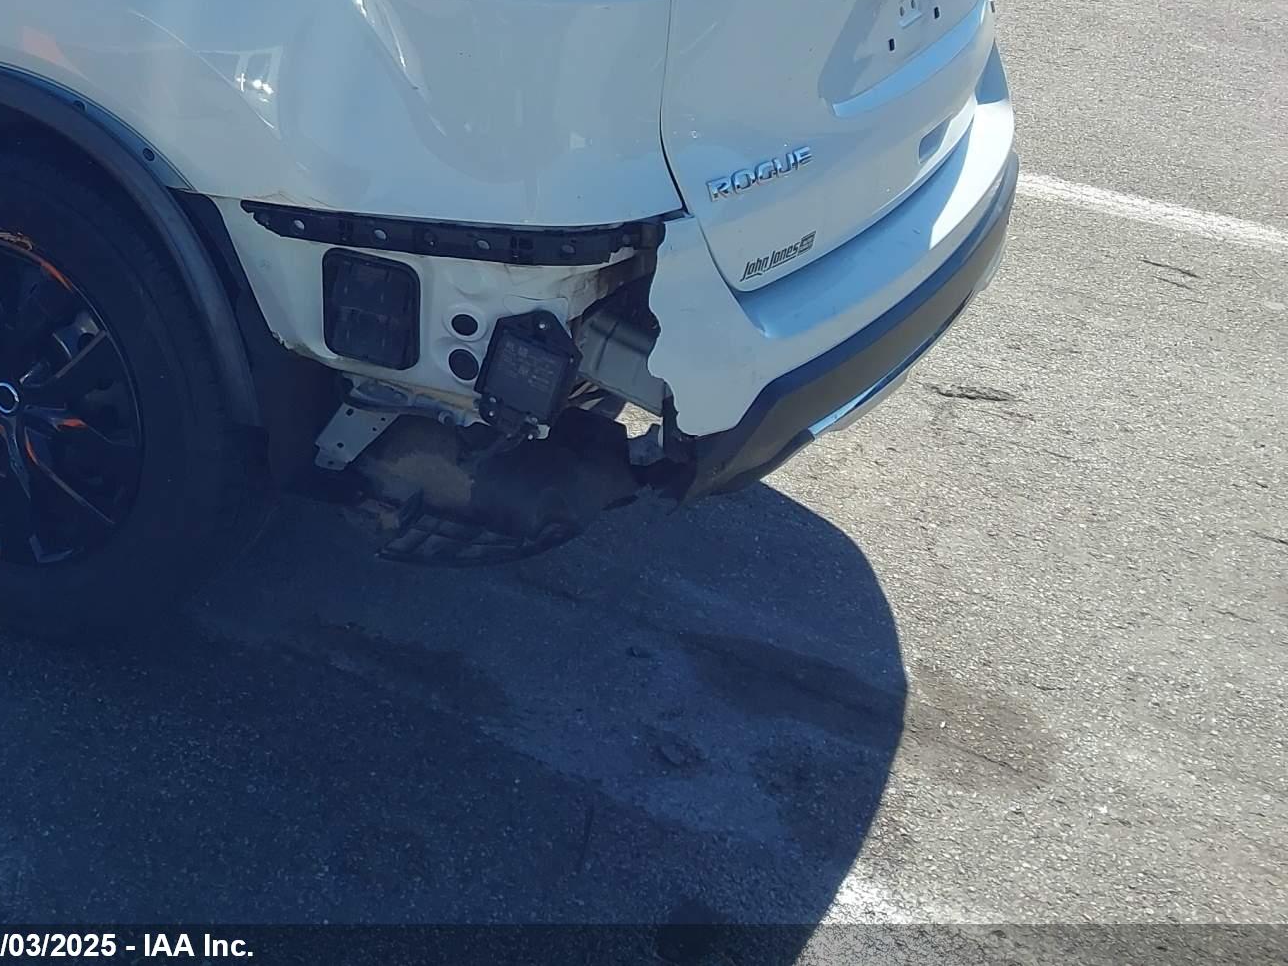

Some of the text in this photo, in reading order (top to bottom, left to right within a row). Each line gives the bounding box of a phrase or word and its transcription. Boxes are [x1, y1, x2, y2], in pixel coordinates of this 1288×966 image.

[706, 146, 812, 202] ROGUE
[740, 256, 770, 282] John
[767, 242, 800, 268] Jones
